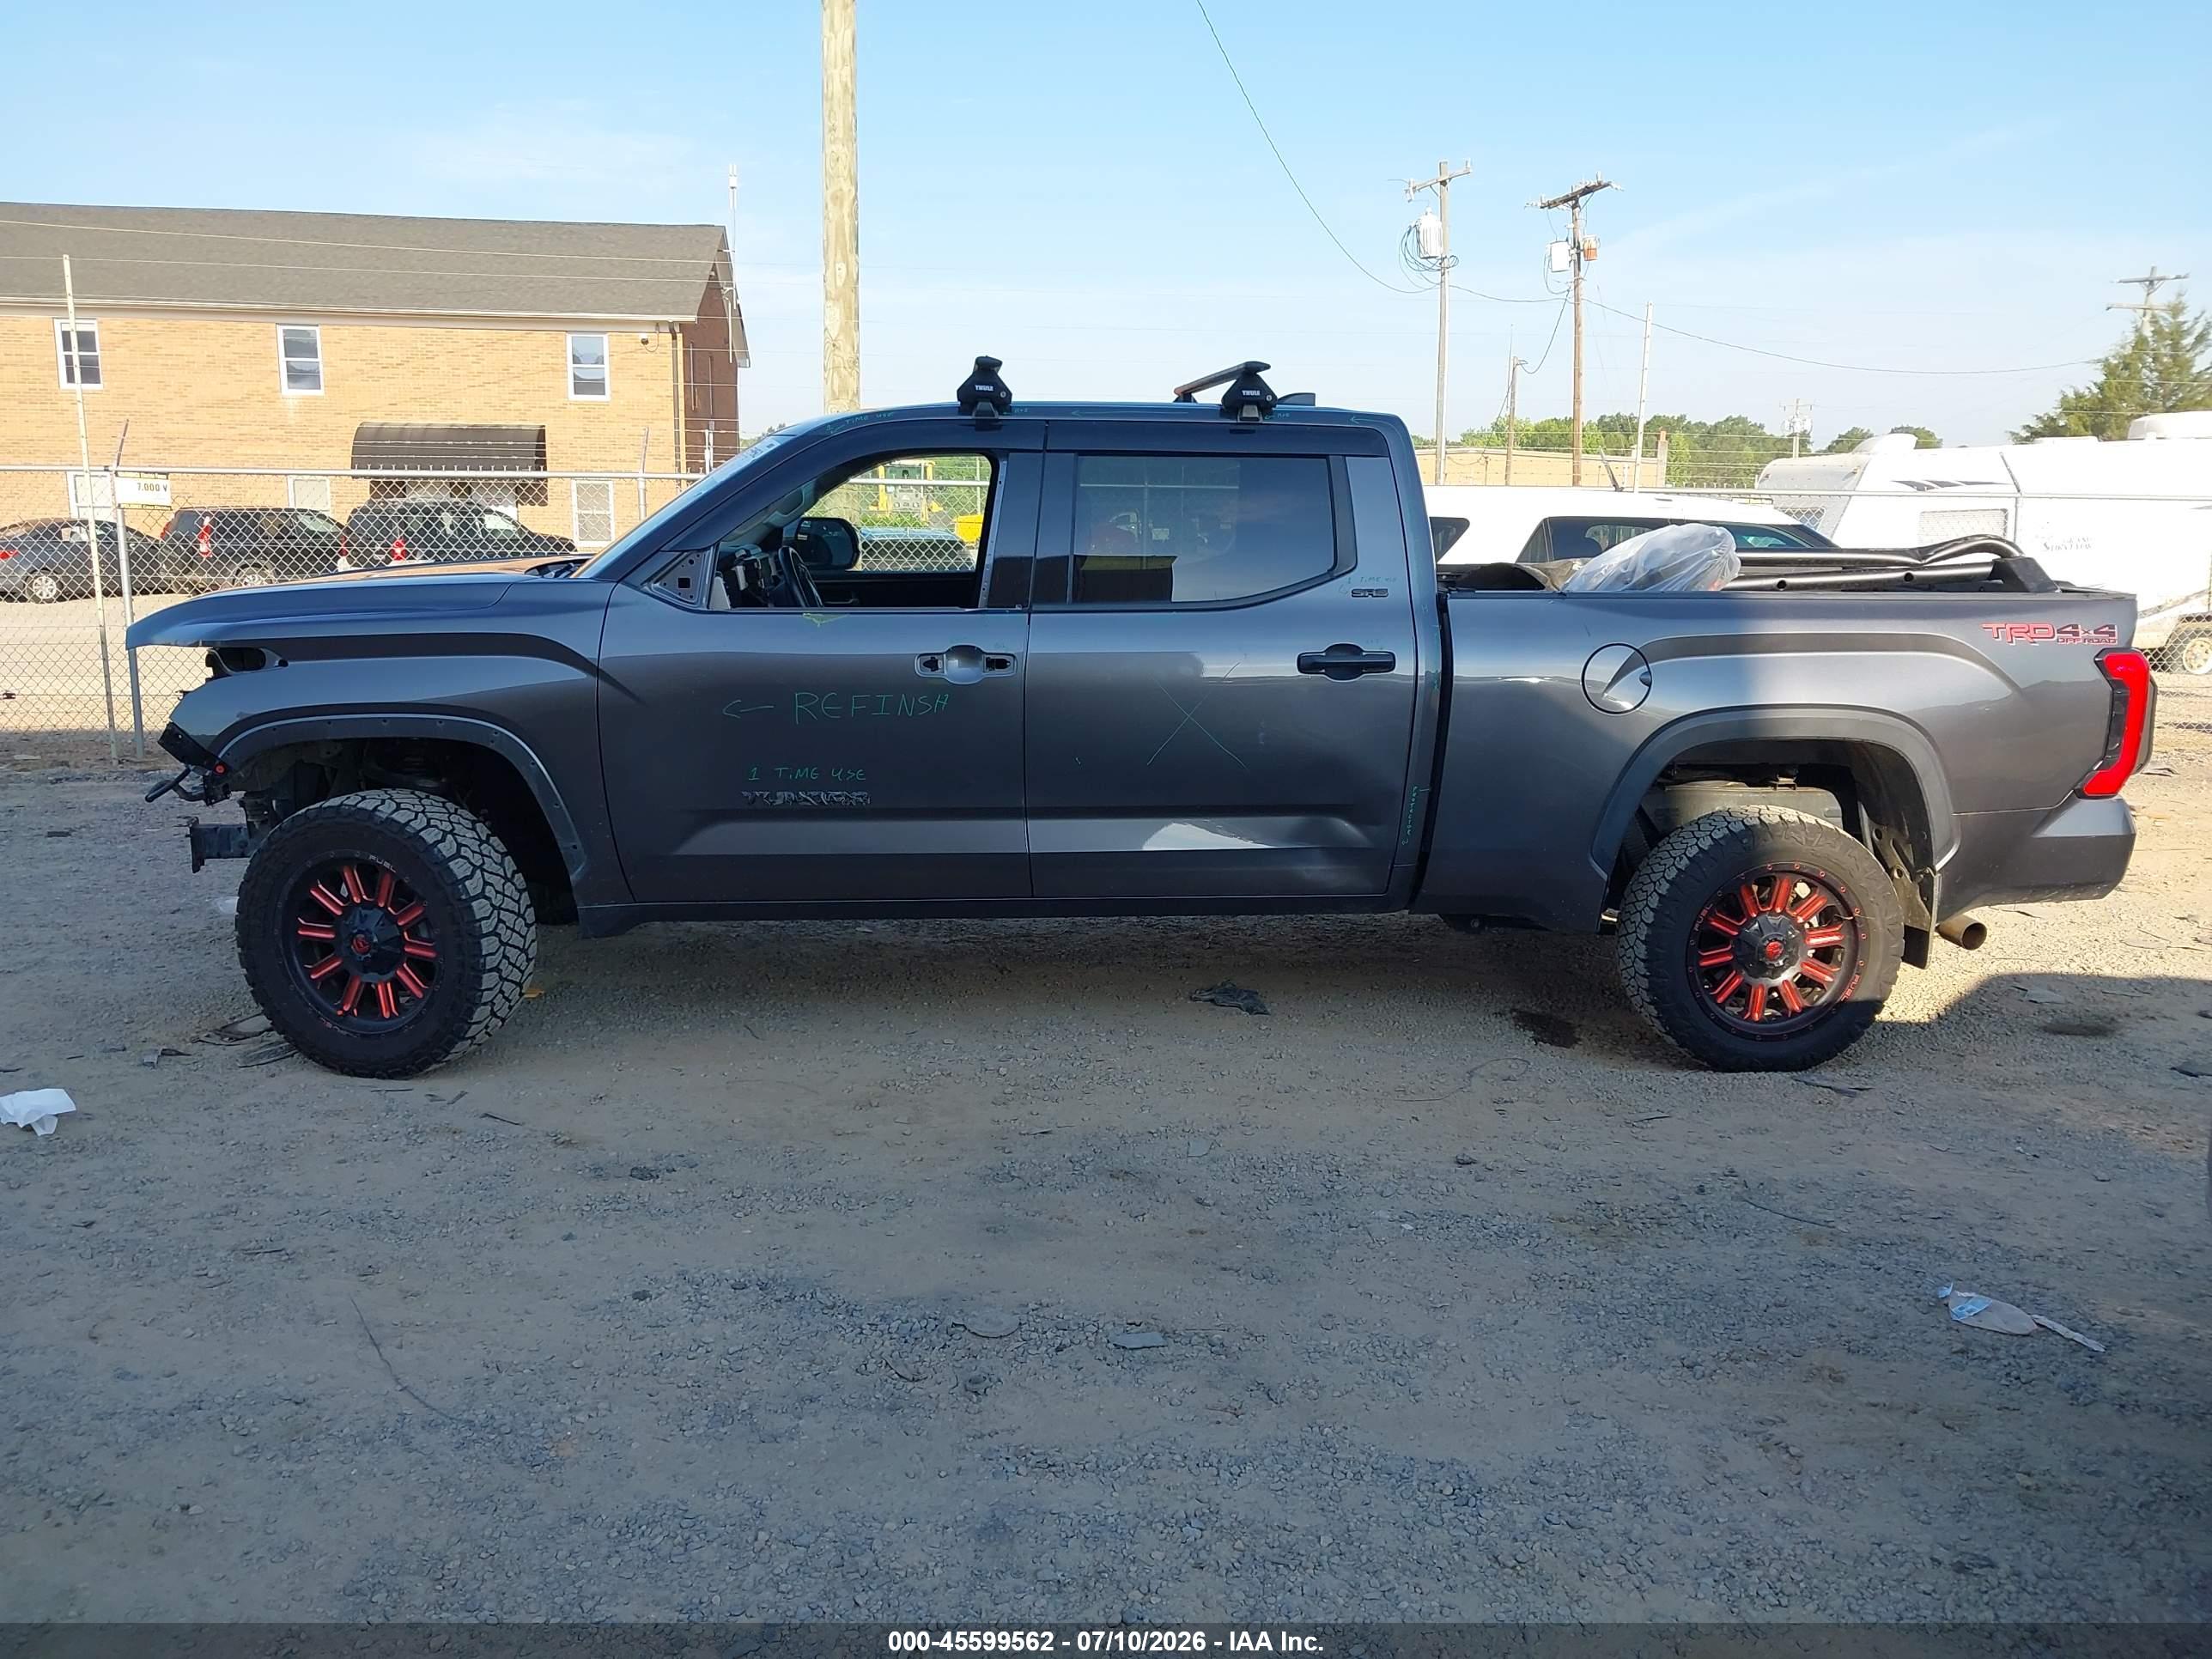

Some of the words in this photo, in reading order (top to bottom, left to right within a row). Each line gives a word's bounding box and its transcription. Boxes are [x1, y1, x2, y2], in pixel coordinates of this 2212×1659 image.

[1981, 622, 2056, 646] TRD
[2056, 623, 2118, 637] 4x4
[831, 767, 866, 781] USE
[368, 854, 398, 873] FUEL
[1692, 903, 1713, 932] FUEL
[1840, 974, 1860, 1001] FUEL
